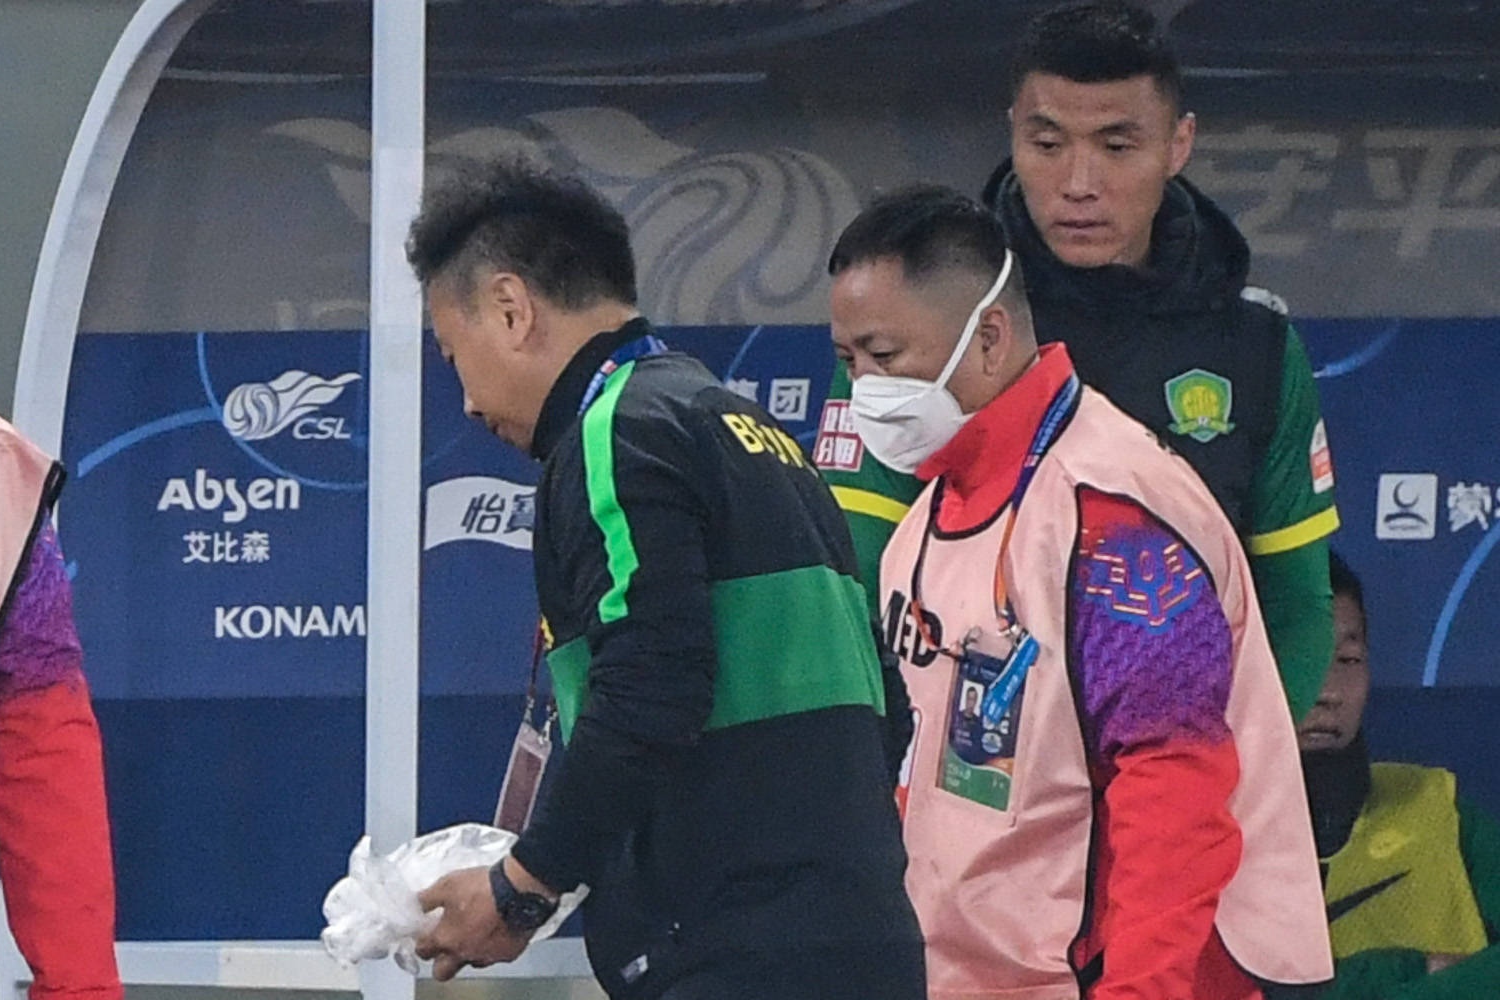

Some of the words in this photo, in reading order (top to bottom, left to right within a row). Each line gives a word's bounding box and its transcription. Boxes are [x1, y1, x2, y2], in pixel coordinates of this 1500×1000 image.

[293, 417, 351, 440] CSL
[156, 468, 301, 524] Absen
[182, 531, 270, 563] 艾比森
[215, 605, 367, 639] KONAM
